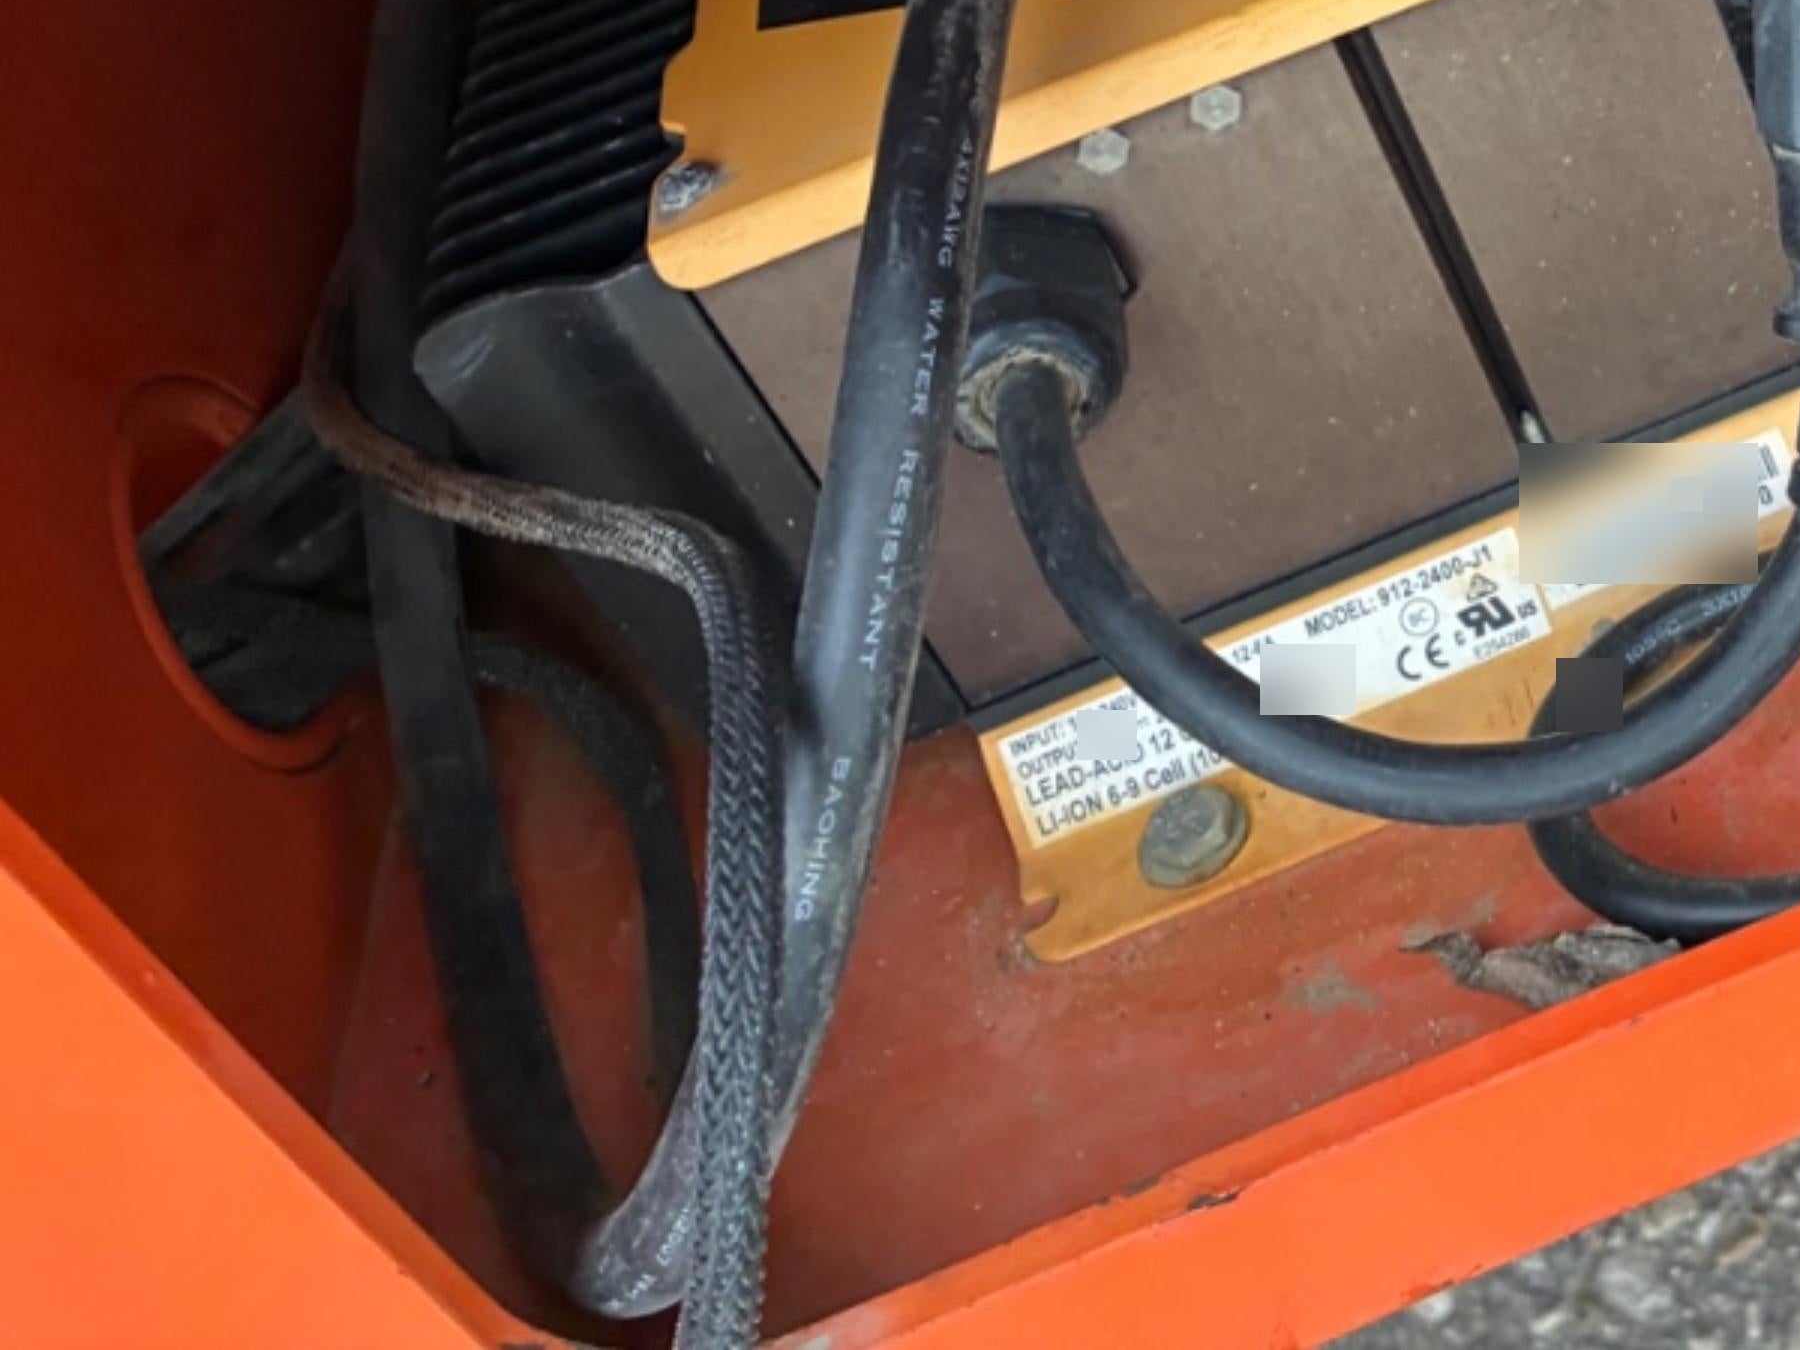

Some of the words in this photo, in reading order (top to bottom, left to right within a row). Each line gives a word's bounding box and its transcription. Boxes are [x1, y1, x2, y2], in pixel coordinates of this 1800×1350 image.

[910, 296, 946, 416] WATER
[858, 449, 922, 672] RESISTANT
[1304, 601, 1378, 637] MODEL:
[1142, 758, 1187, 791] Cell
[793, 756, 852, 922] BAOHING
